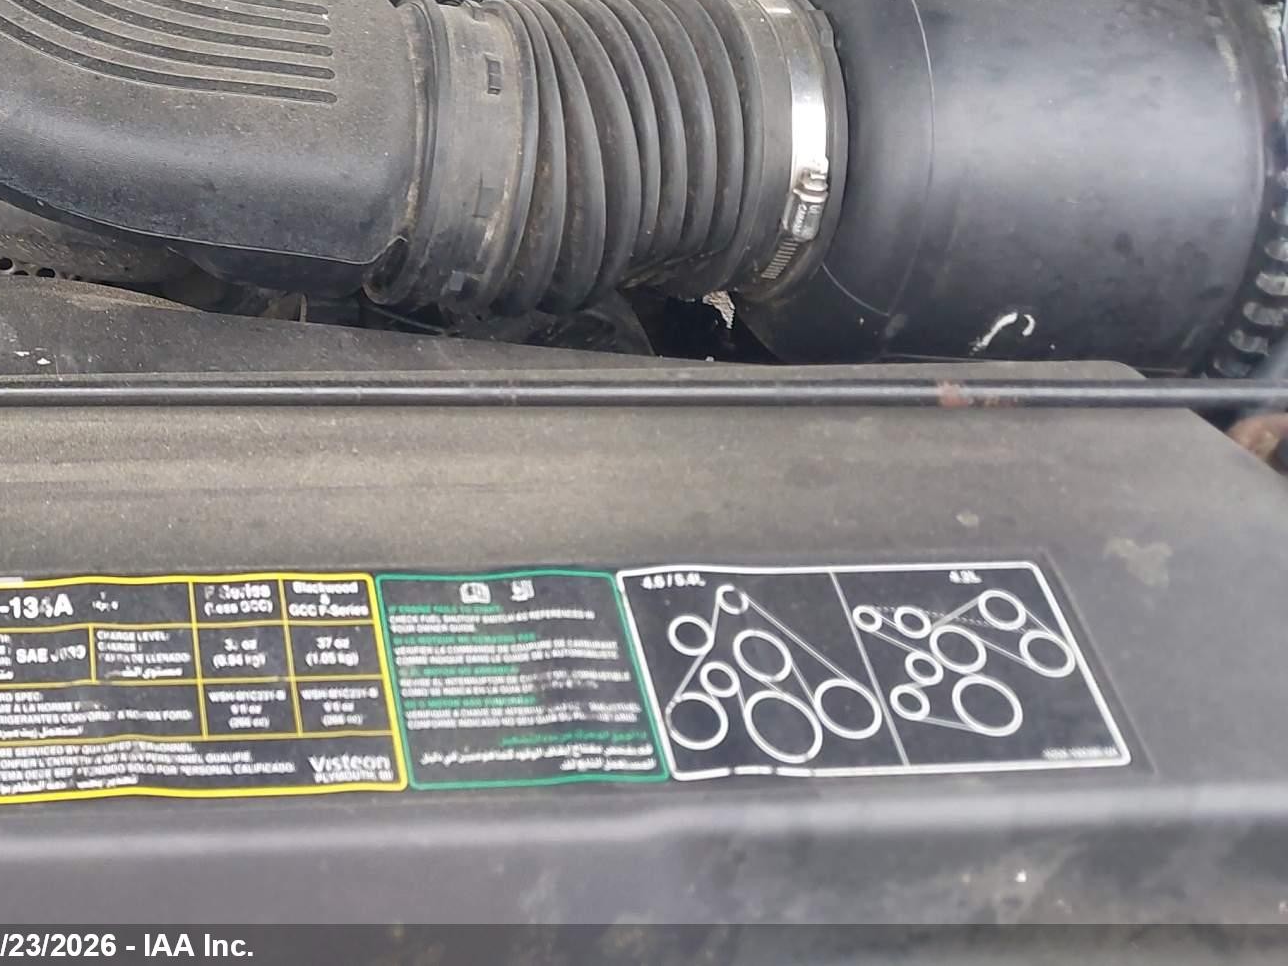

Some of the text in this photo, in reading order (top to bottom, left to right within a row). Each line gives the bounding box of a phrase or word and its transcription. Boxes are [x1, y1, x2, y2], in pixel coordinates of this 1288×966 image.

[224, 638, 238, 651] 3
[316, 636, 332, 649] 37
[16, 647, 48, 664] SAE
[309, 754, 390, 772] Visteon
